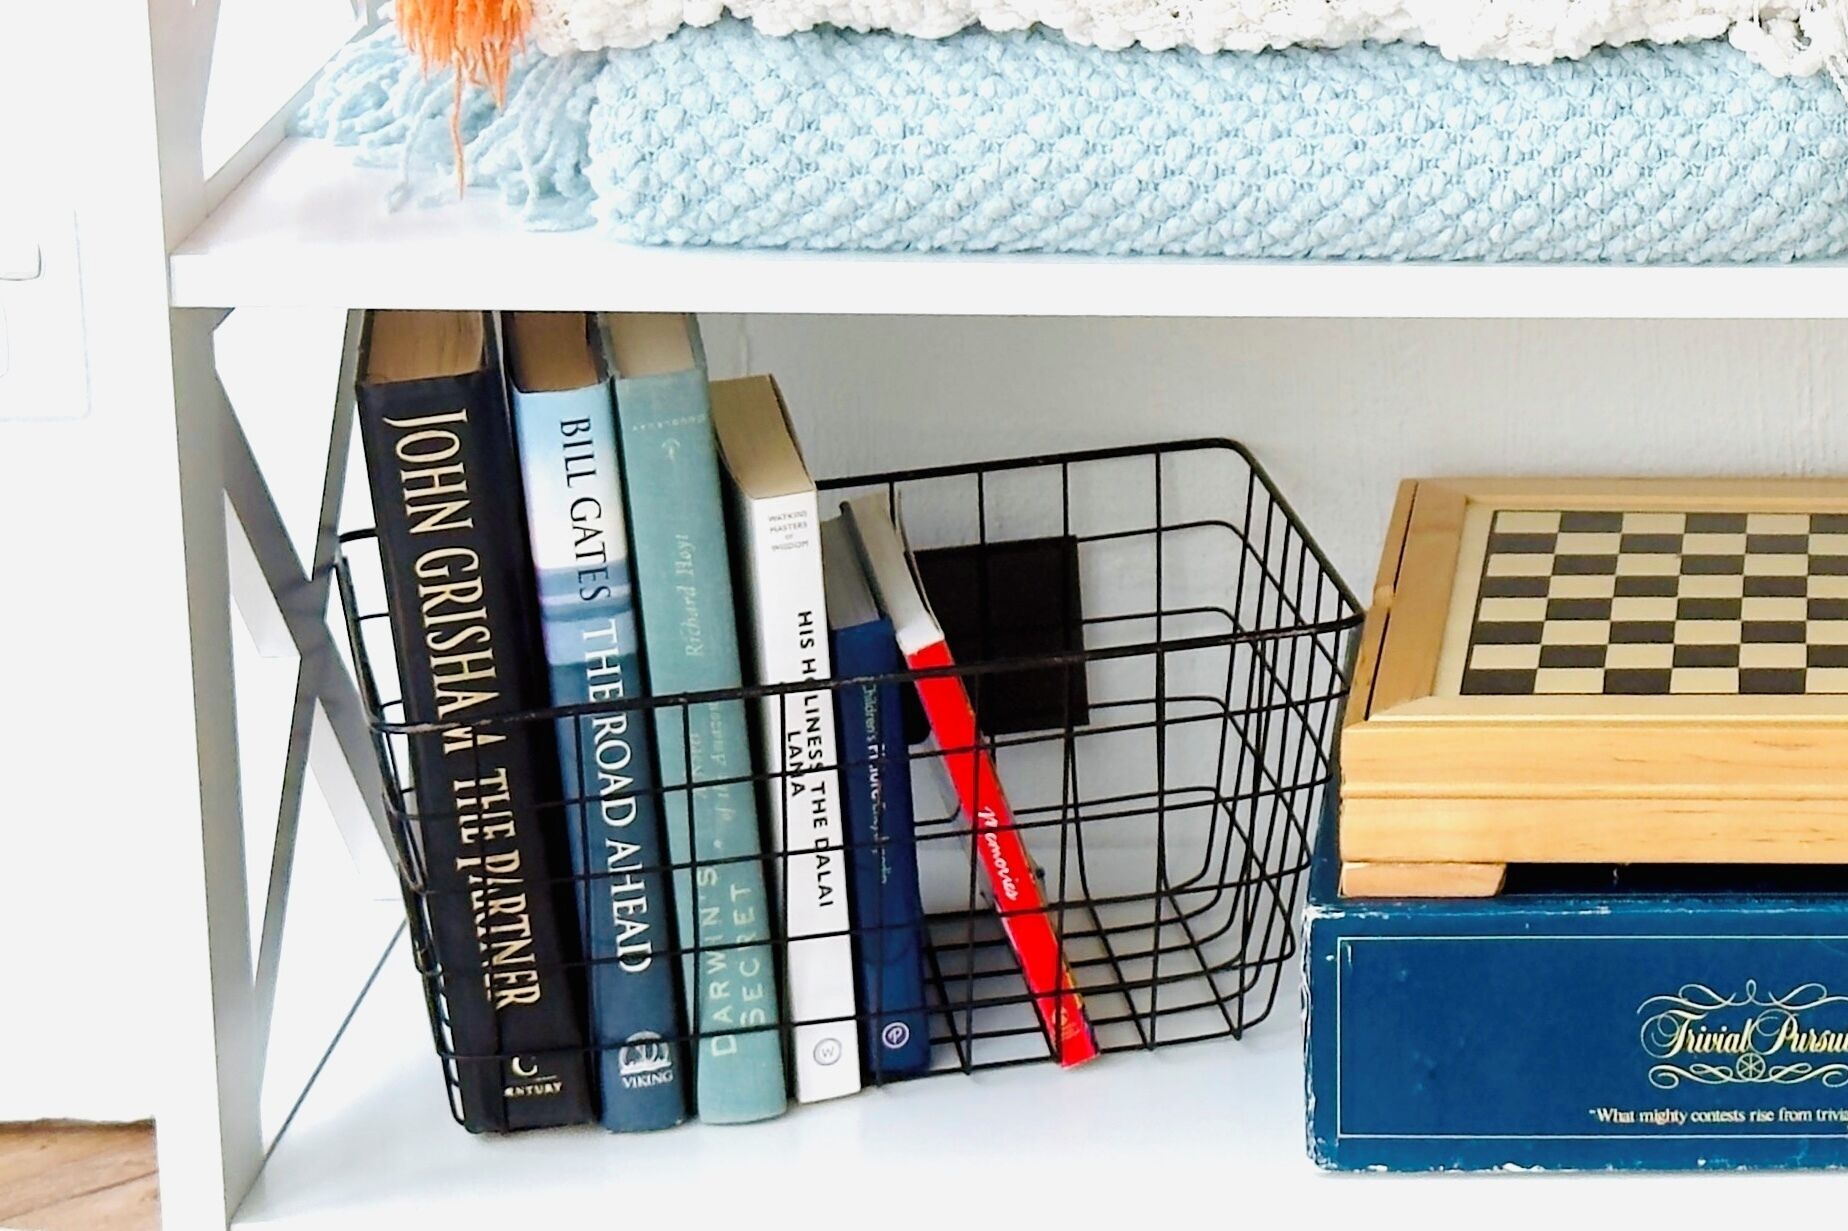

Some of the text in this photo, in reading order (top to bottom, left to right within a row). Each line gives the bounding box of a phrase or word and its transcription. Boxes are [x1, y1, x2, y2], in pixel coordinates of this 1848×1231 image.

[382, 408, 507, 754] JOHN GRISHAM
[560, 415, 611, 602] BILL GATES
[676, 586, 705, 657] Richard
[582, 619, 653, 974] THE ROAD AHEAD
[787, 730, 806, 798] LAMA
[797, 610, 835, 908] HIS HLINESS THE DALAI
[453, 767, 542, 1010] THE PARTNER
[976, 805, 1020, 902] Memories
[699, 865, 738, 1058] DARWIN'S
[730, 882, 766, 1027] SECRET
[623, 1070, 674, 1089] VIKING
[1640, 1008, 1753, 1060] Trivial
[1588, 1107, 1636, 1124] "What
[1639, 1108, 1688, 1126] mighty
[1690, 1107, 1746, 1123] contests
[1749, 1108, 1774, 1122] rise
[1778, 1107, 1813, 1122] from
